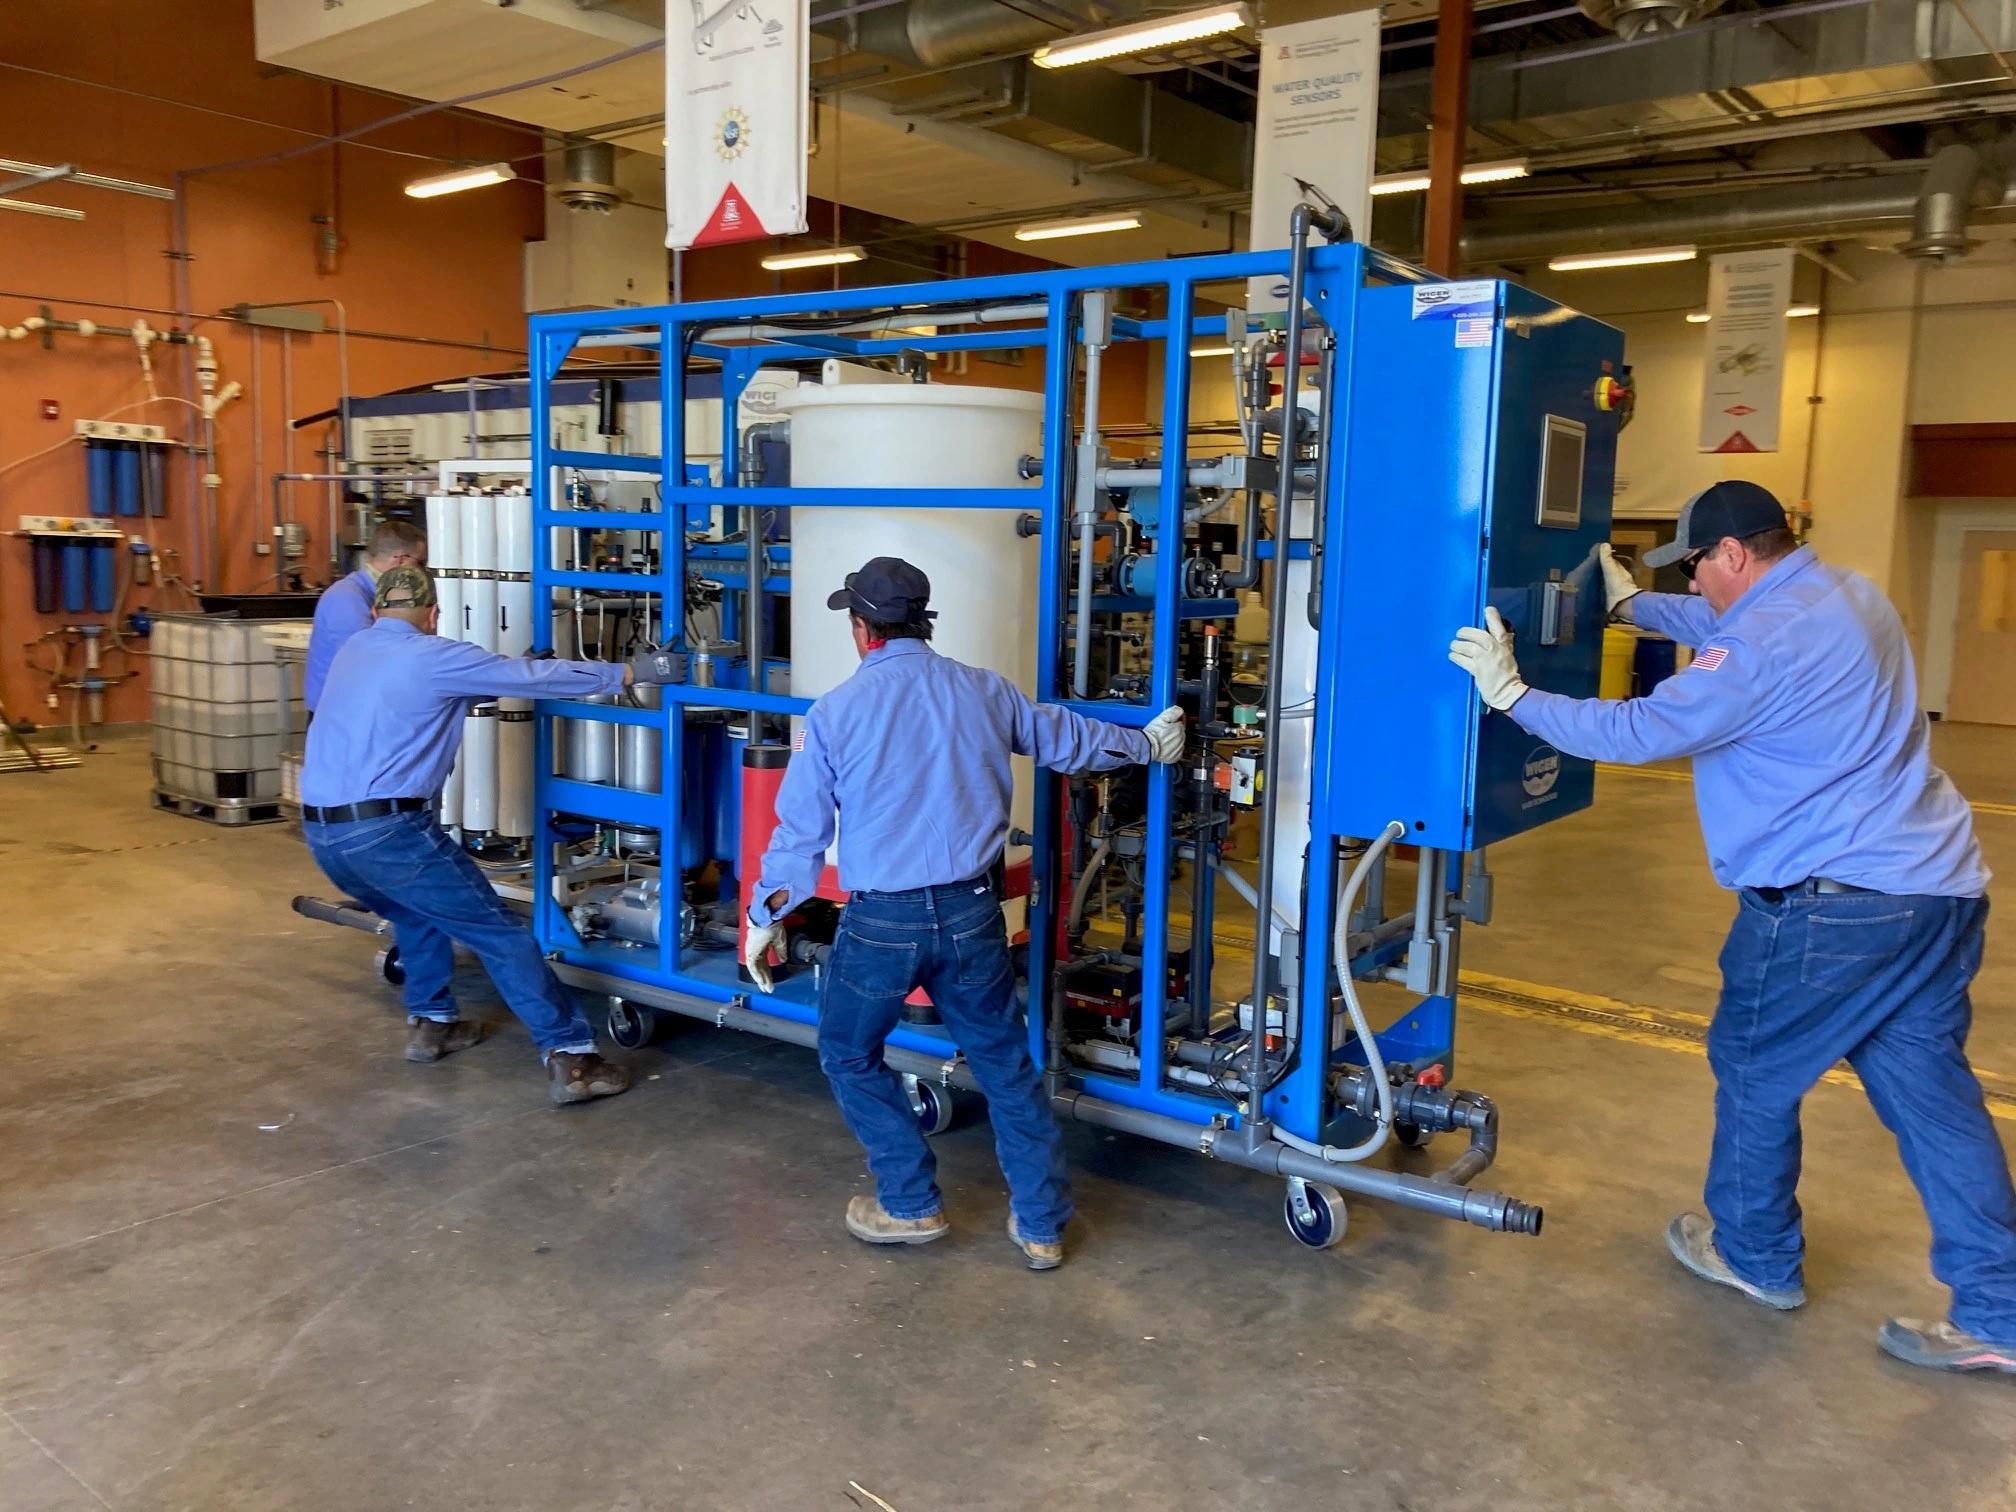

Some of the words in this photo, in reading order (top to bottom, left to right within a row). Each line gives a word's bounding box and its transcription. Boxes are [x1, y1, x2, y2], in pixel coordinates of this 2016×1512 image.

[1272, 79, 1311, 94] WATER
[1312, 72, 1362, 89] QUALITY
[1290, 89, 1342, 106] SENSORS
